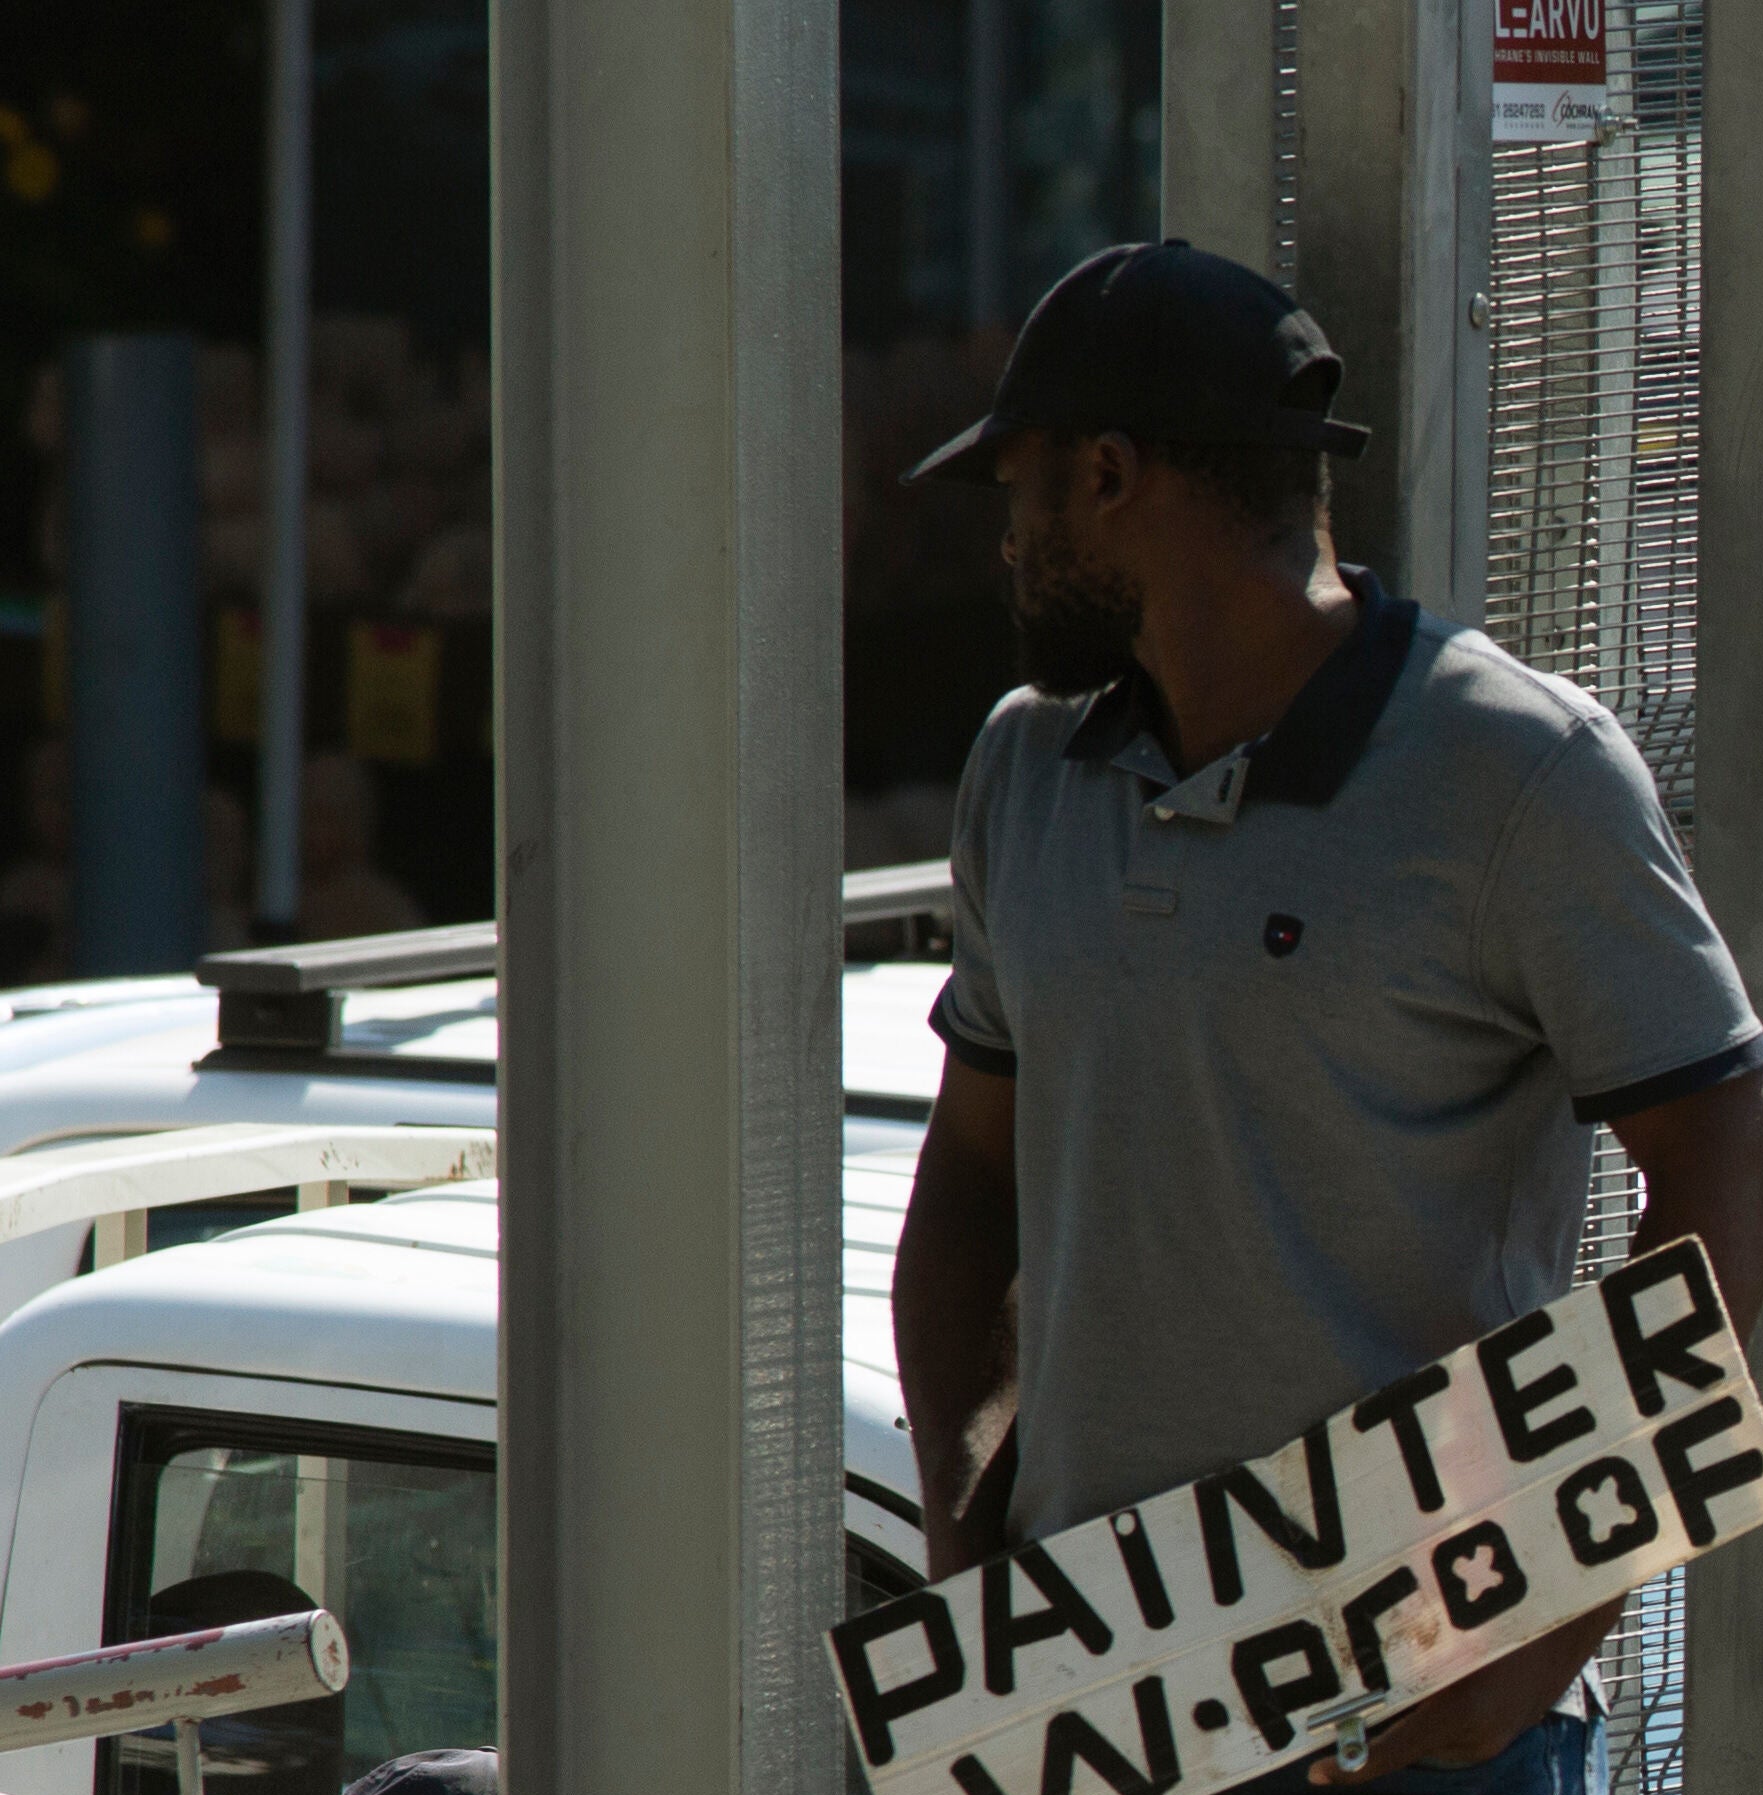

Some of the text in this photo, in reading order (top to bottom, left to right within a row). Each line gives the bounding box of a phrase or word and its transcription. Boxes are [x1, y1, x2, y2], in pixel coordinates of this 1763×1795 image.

[1495, 0, 1599, 39] LEARVU
[1535, 50, 1575, 63] INVISIBLE
[1578, 51, 1600, 64] WALL
[834, 1246, 1725, 1766] PAINTER
